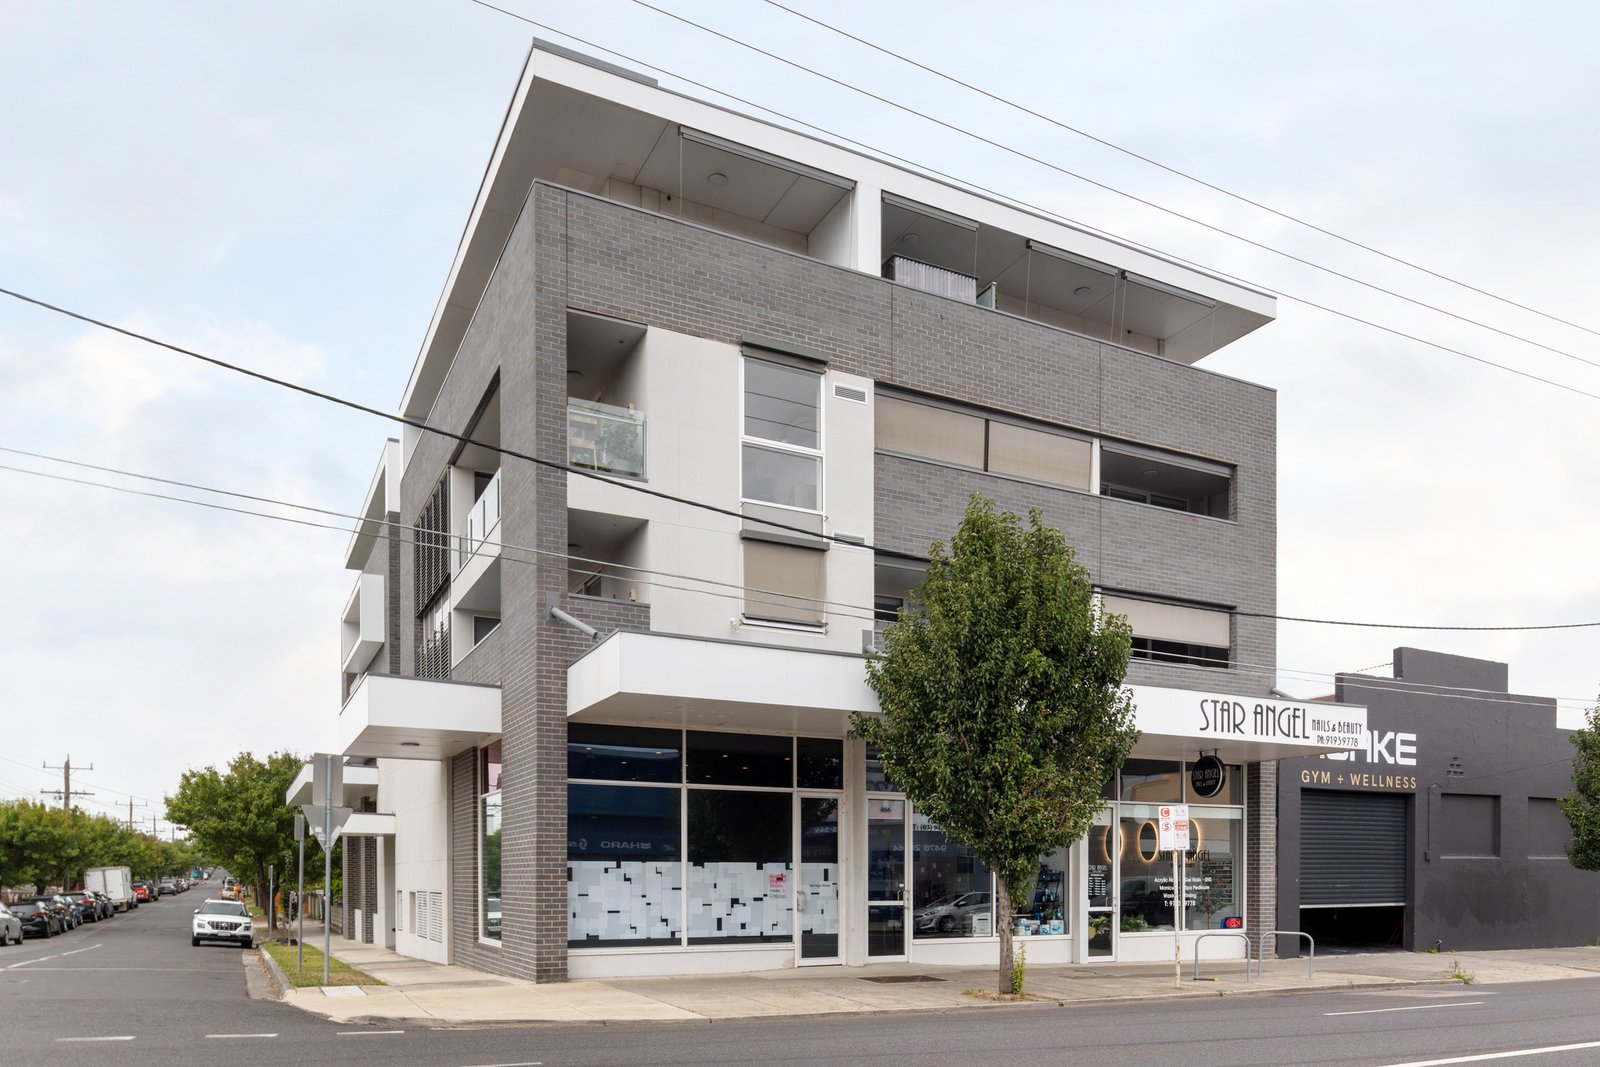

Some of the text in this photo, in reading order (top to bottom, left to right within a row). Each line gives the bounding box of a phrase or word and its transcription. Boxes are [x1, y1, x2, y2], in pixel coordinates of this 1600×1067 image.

[1200, 699, 1310, 740] STAR ANGEL
[1312, 719, 1362, 735] NAILS & BEAUTY
[1301, 770, 1331, 784] GYM
[1350, 773, 1417, 789] WELLNESS
